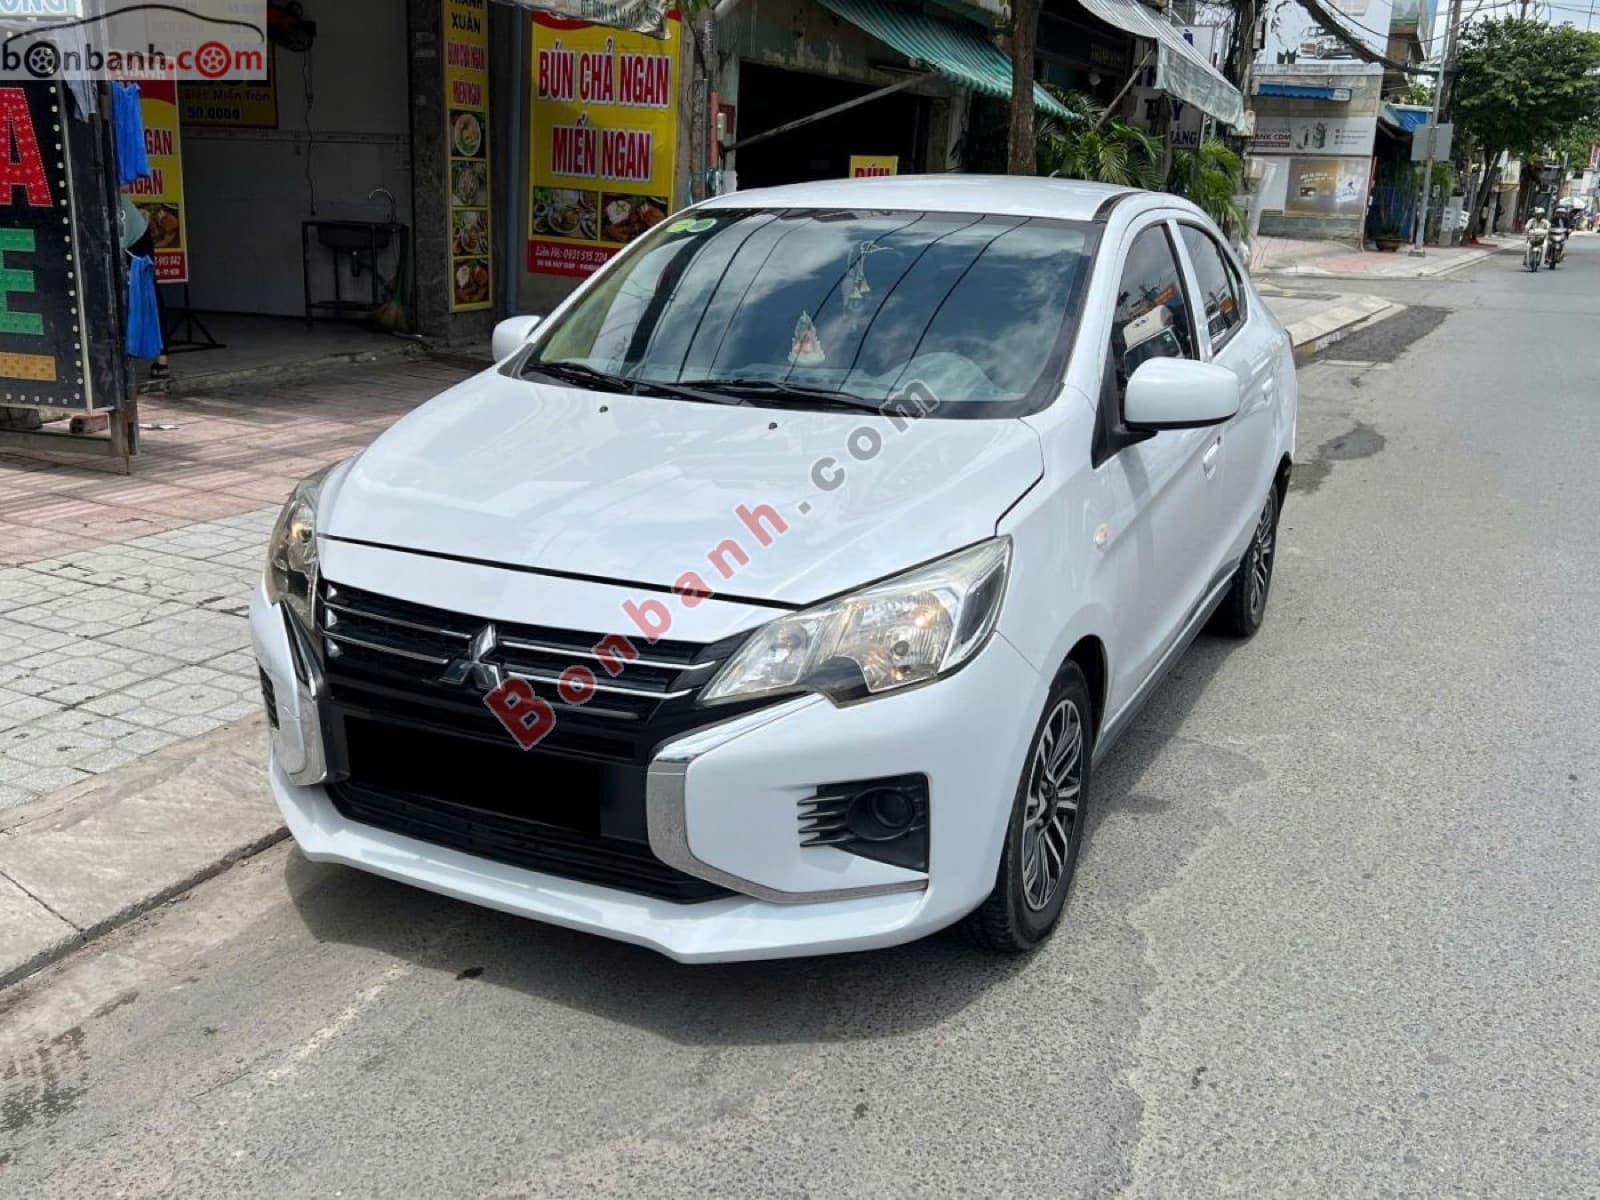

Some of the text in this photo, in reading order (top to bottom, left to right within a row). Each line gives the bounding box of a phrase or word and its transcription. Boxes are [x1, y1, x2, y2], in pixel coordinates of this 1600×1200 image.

[538, 38, 669, 105] BÚN CHẢ NGAN
[146, 129, 172, 155] GAN
[552, 113, 651, 179] MIẾN NGAN
[128, 168, 163, 194] GAN
